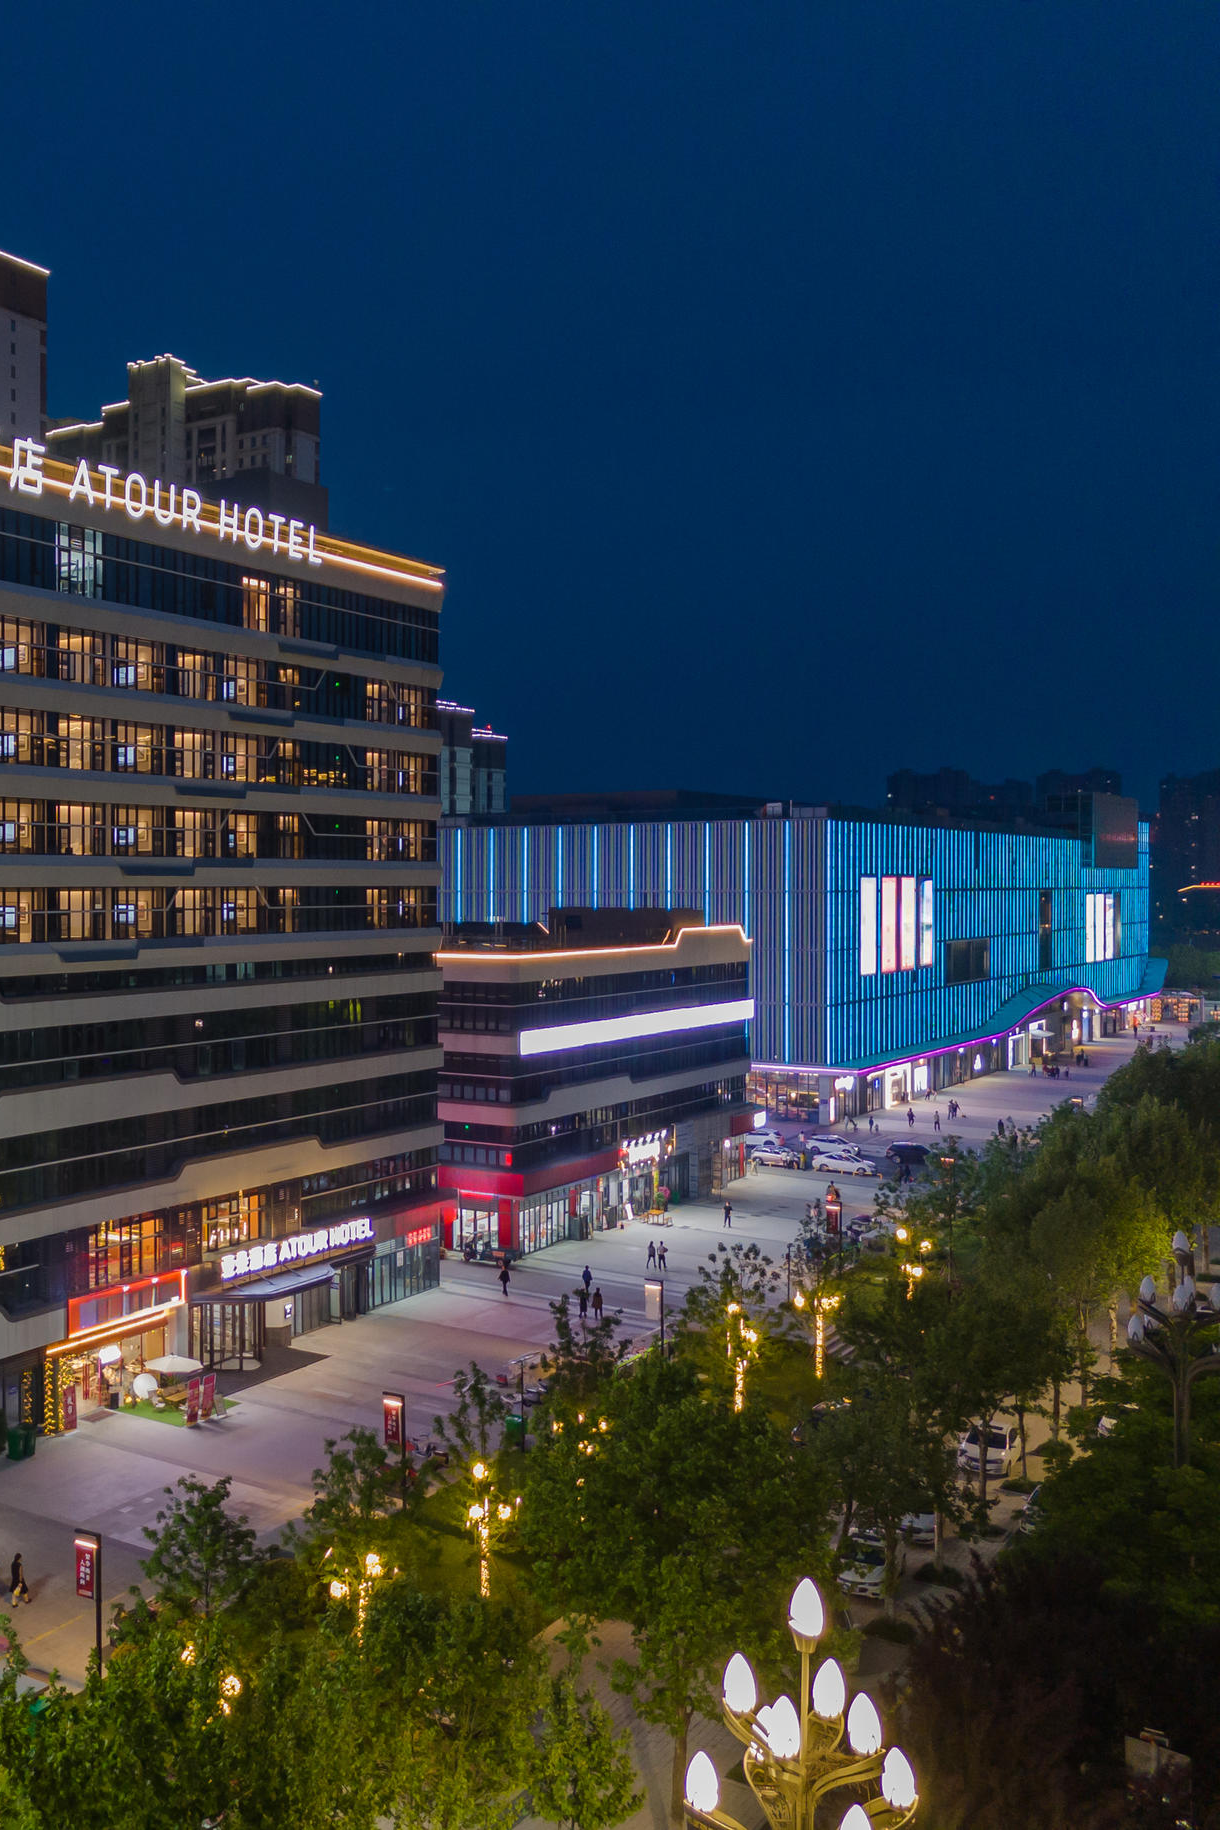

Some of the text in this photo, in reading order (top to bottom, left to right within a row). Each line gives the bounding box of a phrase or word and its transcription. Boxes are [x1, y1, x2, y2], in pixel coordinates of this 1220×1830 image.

[69, 458, 201, 532] ATOUR
[219, 499, 323, 564] HOTEL
[279, 1229, 329, 1262] ATOUR
[329, 1218, 374, 1247] HOTEL
